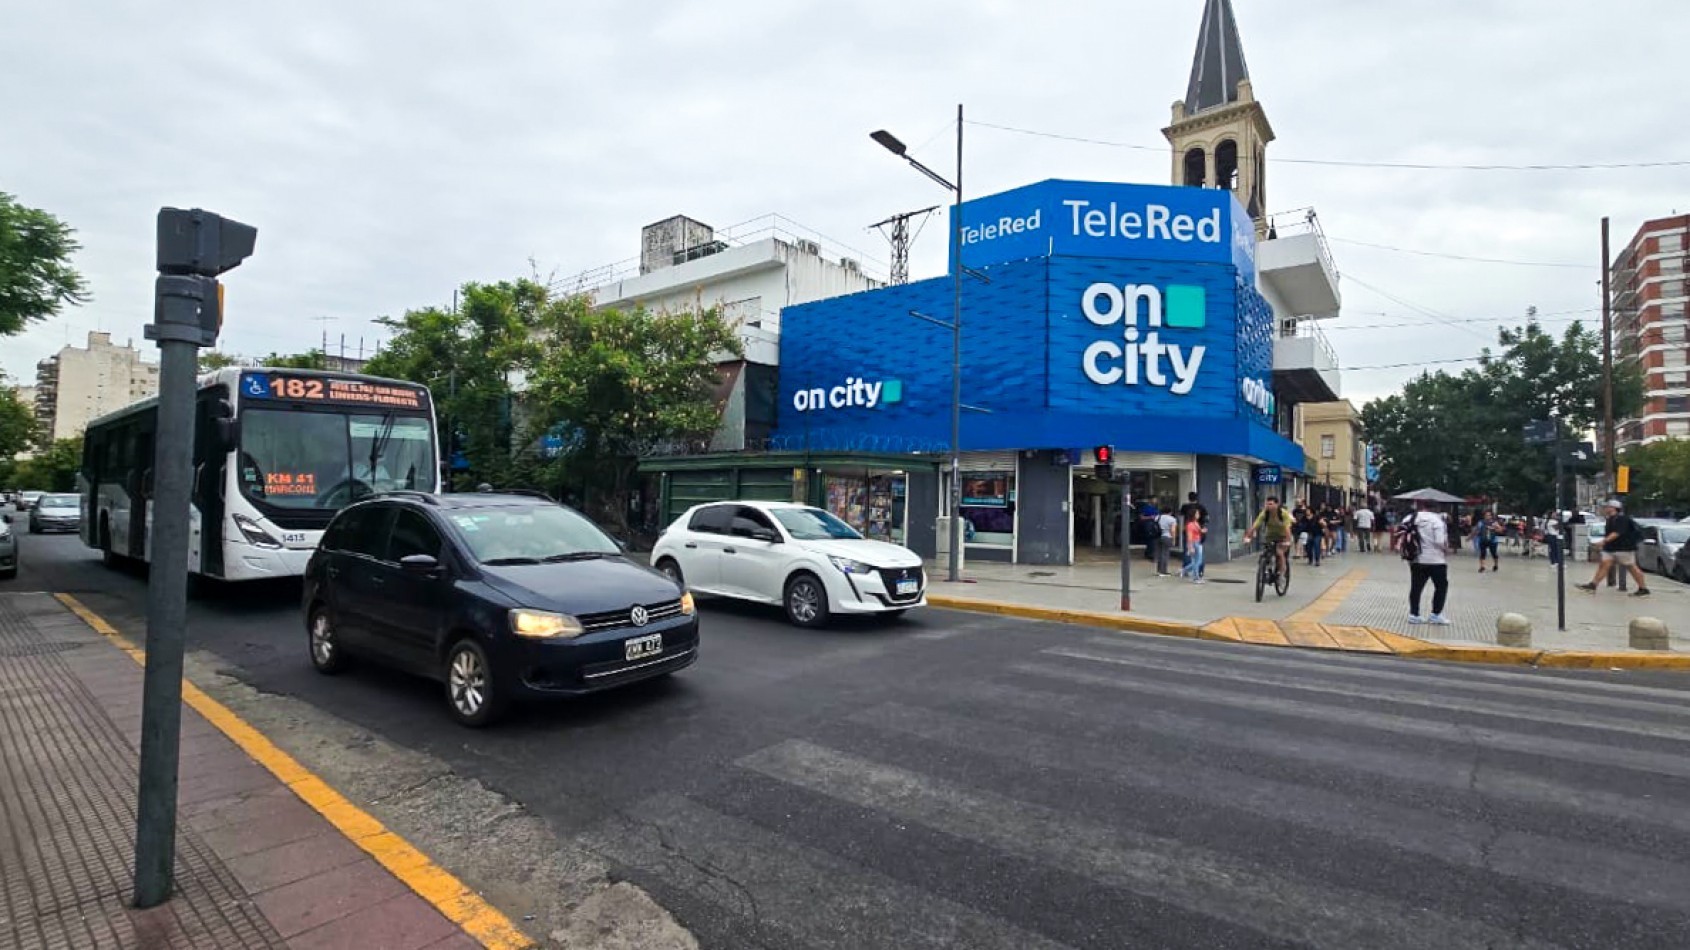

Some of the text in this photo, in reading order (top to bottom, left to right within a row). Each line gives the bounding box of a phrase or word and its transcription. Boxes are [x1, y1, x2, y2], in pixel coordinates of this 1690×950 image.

[960, 209, 1041, 246] TeleRed
[1063, 200, 1220, 243] TeleRed
[1082, 282, 1161, 327] on
[1083, 326, 1206, 394] city
[270, 378, 324, 398] 182
[793, 377, 882, 411] on city
[268, 473, 314, 484] KM 41
